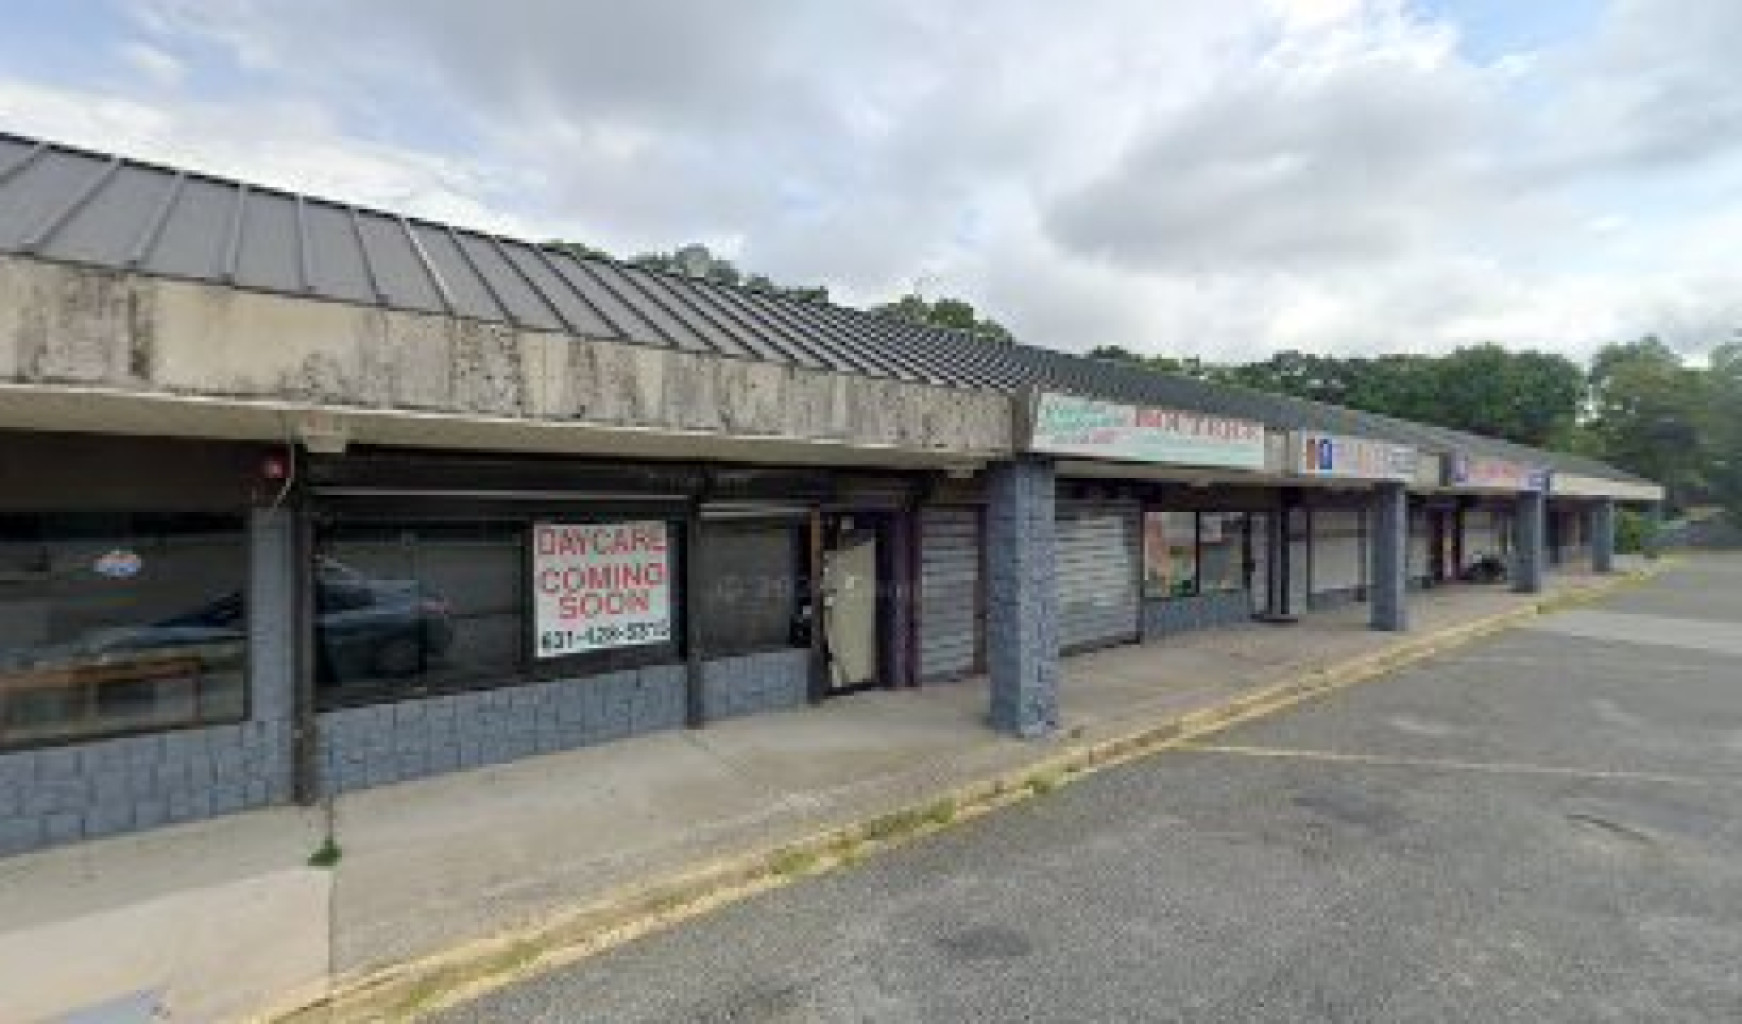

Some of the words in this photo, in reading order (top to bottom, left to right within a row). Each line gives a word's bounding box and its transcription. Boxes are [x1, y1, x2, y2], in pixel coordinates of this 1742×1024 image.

[538, 528, 668, 554] DAYCARE
[541, 562, 667, 593] COMING
[559, 589, 650, 620] SOON
